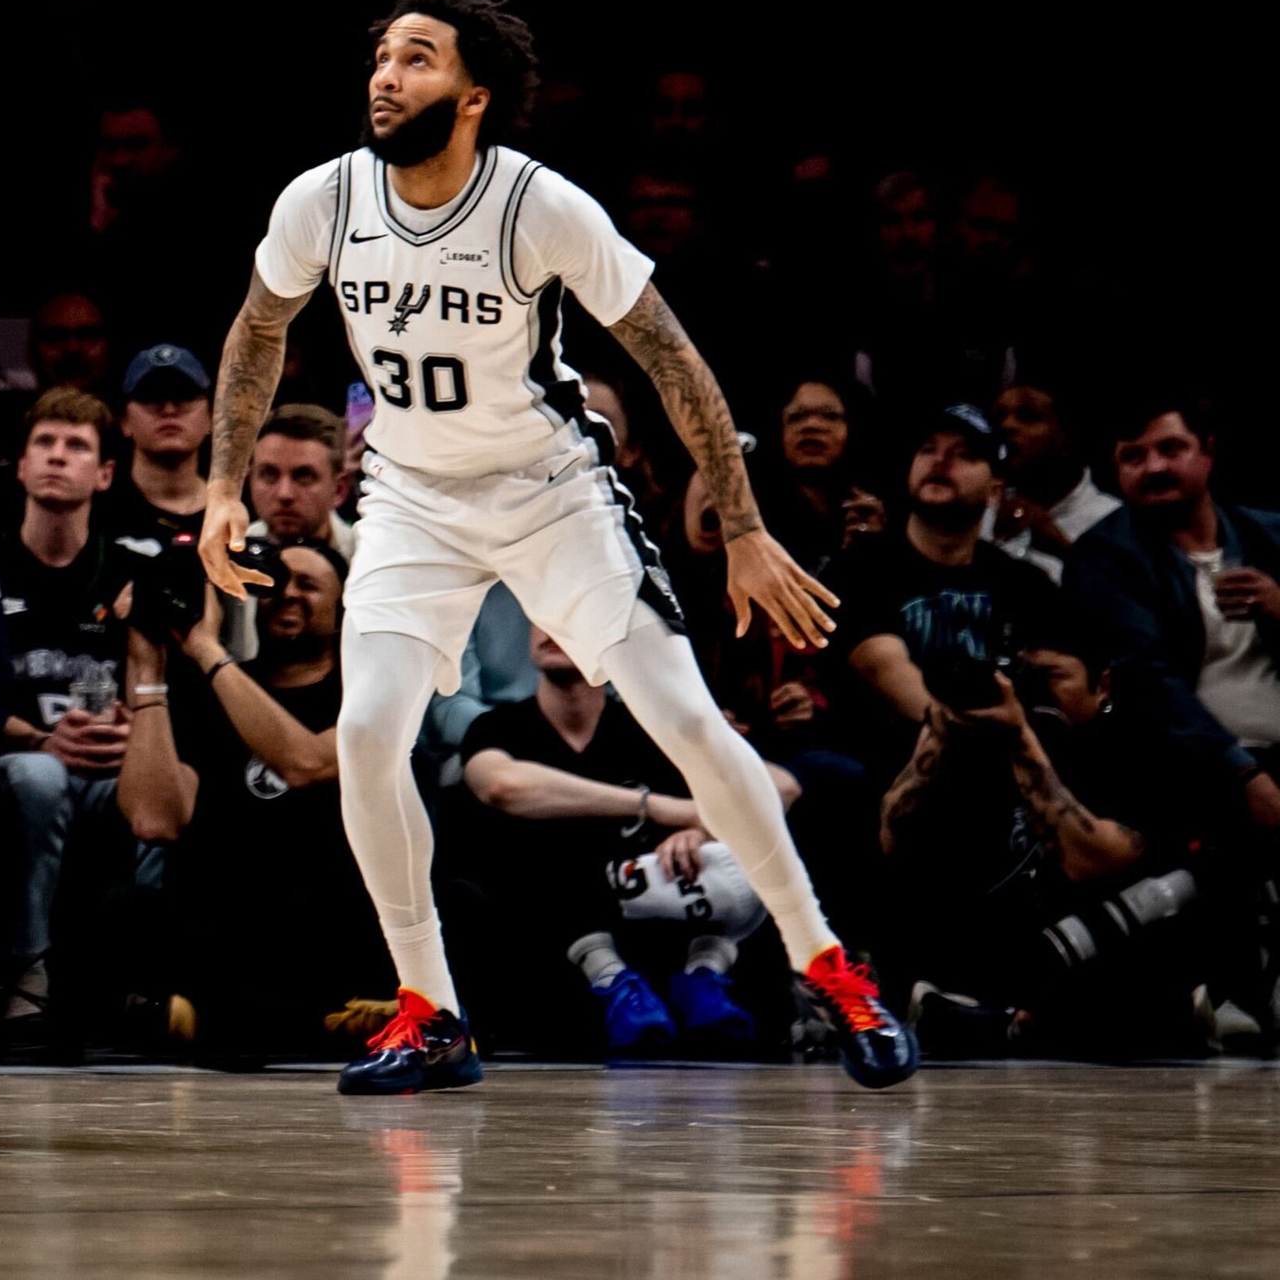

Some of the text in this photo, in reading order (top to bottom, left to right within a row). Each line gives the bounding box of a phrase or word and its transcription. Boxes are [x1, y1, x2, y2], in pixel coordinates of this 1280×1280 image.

[446, 252, 483, 262] LEDGER
[341, 281, 503, 337] SPURS
[371, 346, 472, 415] 30
